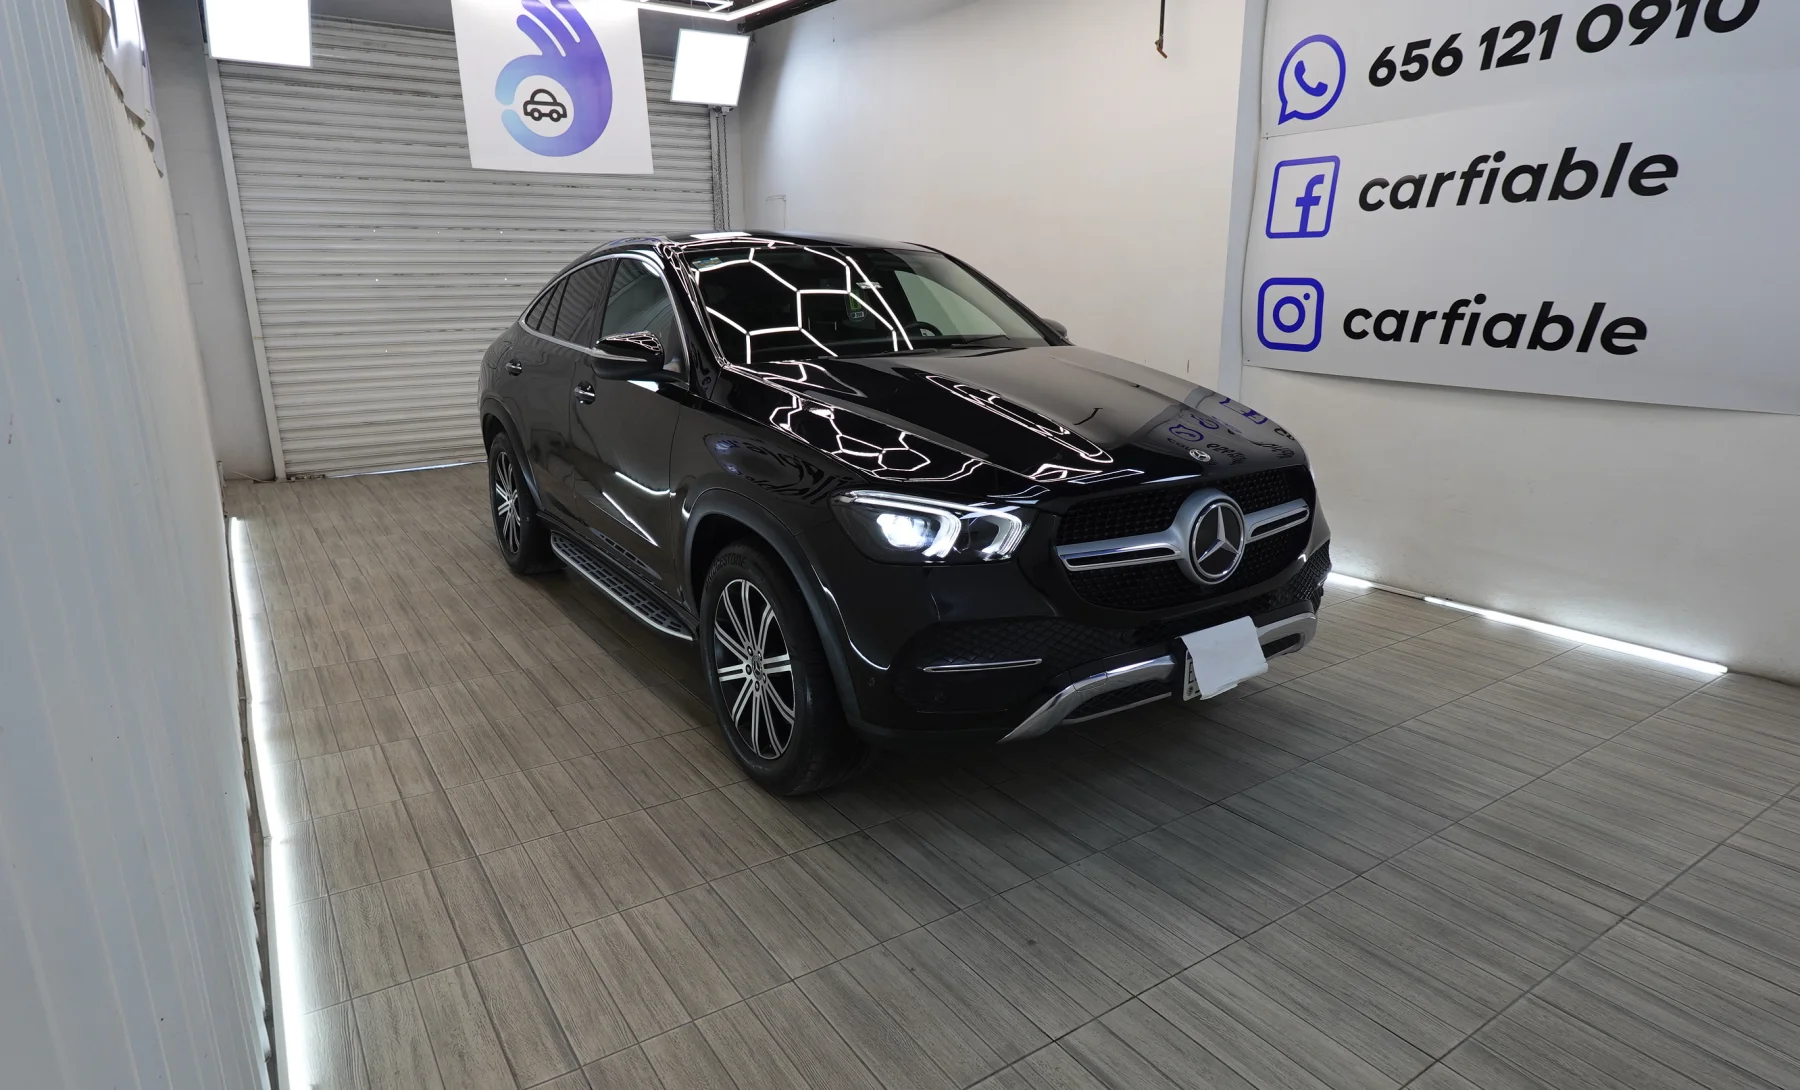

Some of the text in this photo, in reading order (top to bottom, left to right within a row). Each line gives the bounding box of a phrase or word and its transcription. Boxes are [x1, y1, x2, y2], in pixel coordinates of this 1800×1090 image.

[1368, 0, 1761, 88] 656 121 0910
[1358, 142, 1679, 212] carfiable
[1343, 294, 1648, 356] carfiable
